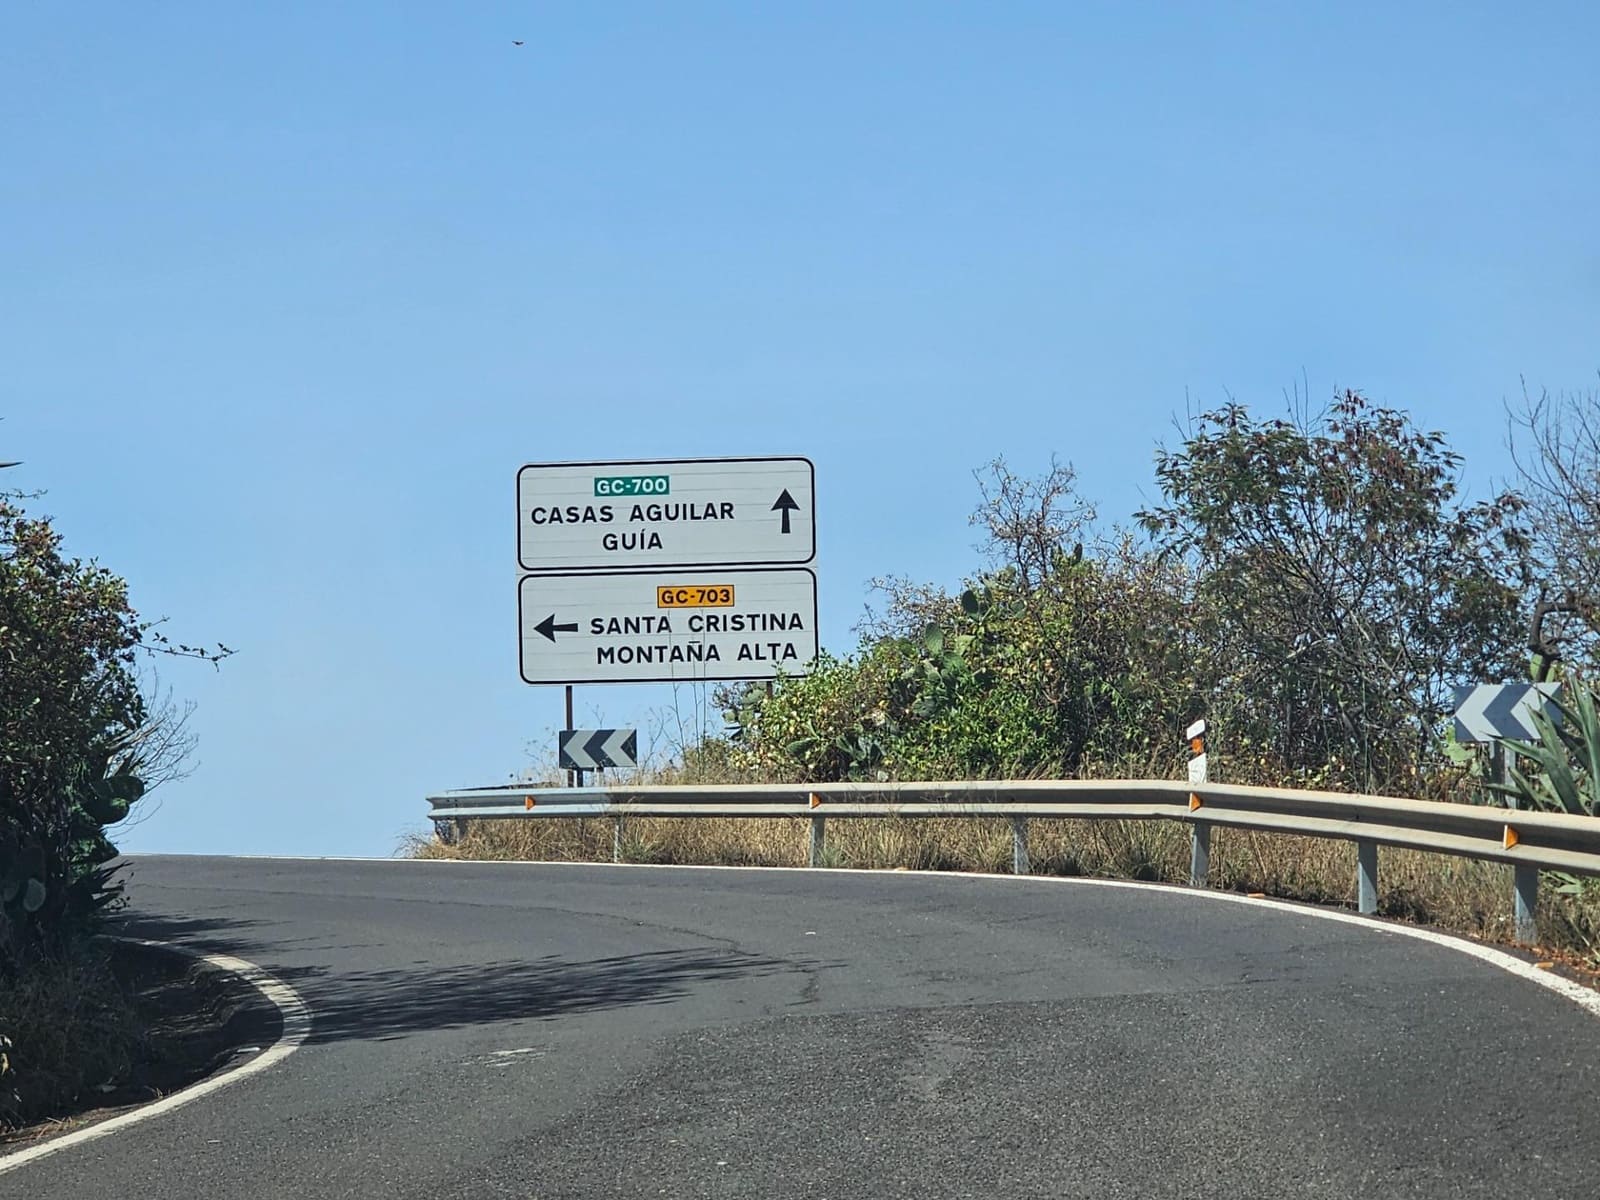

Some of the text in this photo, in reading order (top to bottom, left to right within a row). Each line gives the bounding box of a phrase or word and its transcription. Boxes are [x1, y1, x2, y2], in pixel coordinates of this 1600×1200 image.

[597, 478, 667, 494] GC-700
[532, 502, 735, 525] CASAS AGUILAR
[602, 528, 663, 551] GUÍA
[661, 588, 731, 605] GC-703
[590, 613, 804, 635] SANTA CRISTINA
[597, 640, 798, 665] MONTAÑA ALTA
